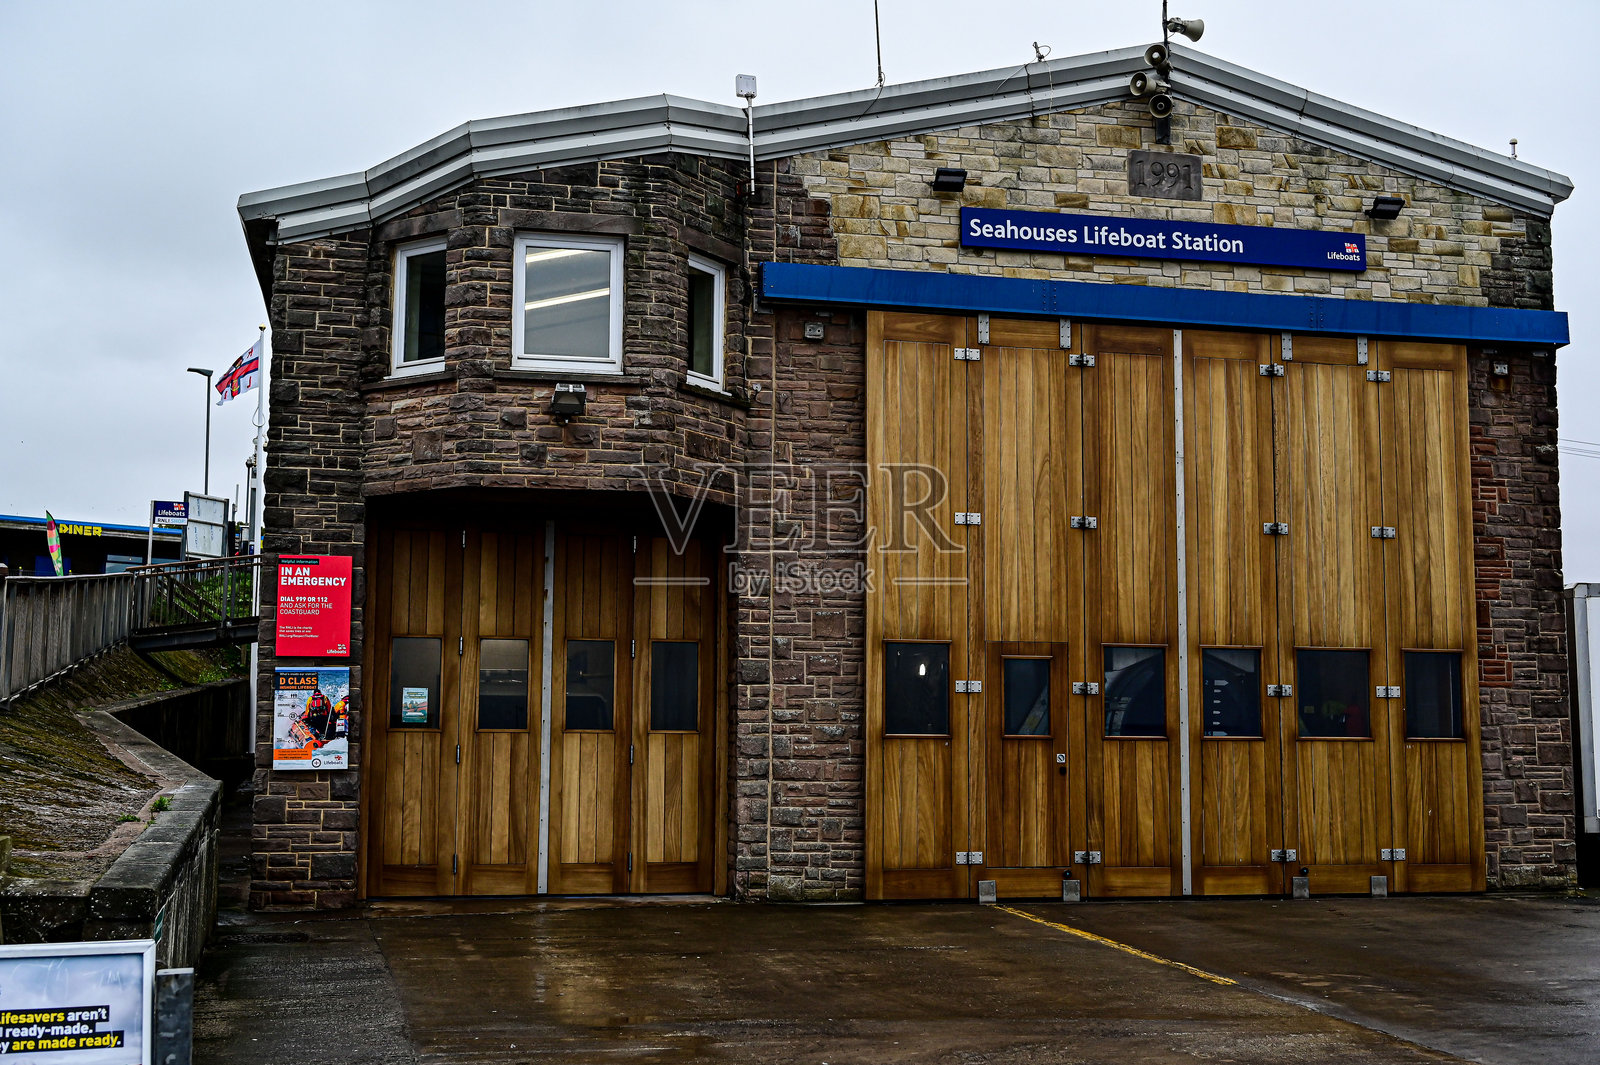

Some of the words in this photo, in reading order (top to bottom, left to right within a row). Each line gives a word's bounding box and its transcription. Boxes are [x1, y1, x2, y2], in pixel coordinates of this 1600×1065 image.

[1136, 160, 1194, 191] 1991
[969, 218, 1078, 243] Seahouses
[1083, 225, 1166, 249] Lifeboat
[1172, 231, 1244, 253] Station
[1327, 251, 1360, 261] Lifeboats
[59, 524, 102, 536] DINER
[281, 567, 292, 575] IN
[295, 567, 310, 576] AN
[281, 577, 346, 586] EMERGENCY
[279, 677, 286, 685] D
[288, 677, 318, 686] CLASS
[66, 1008, 107, 1021] aren't
[5, 1022, 93, 1039] ready-made.
[11, 1039, 35, 1051] are
[38, 1036, 76, 1049] made
[79, 1034, 121, 1048] ready.
